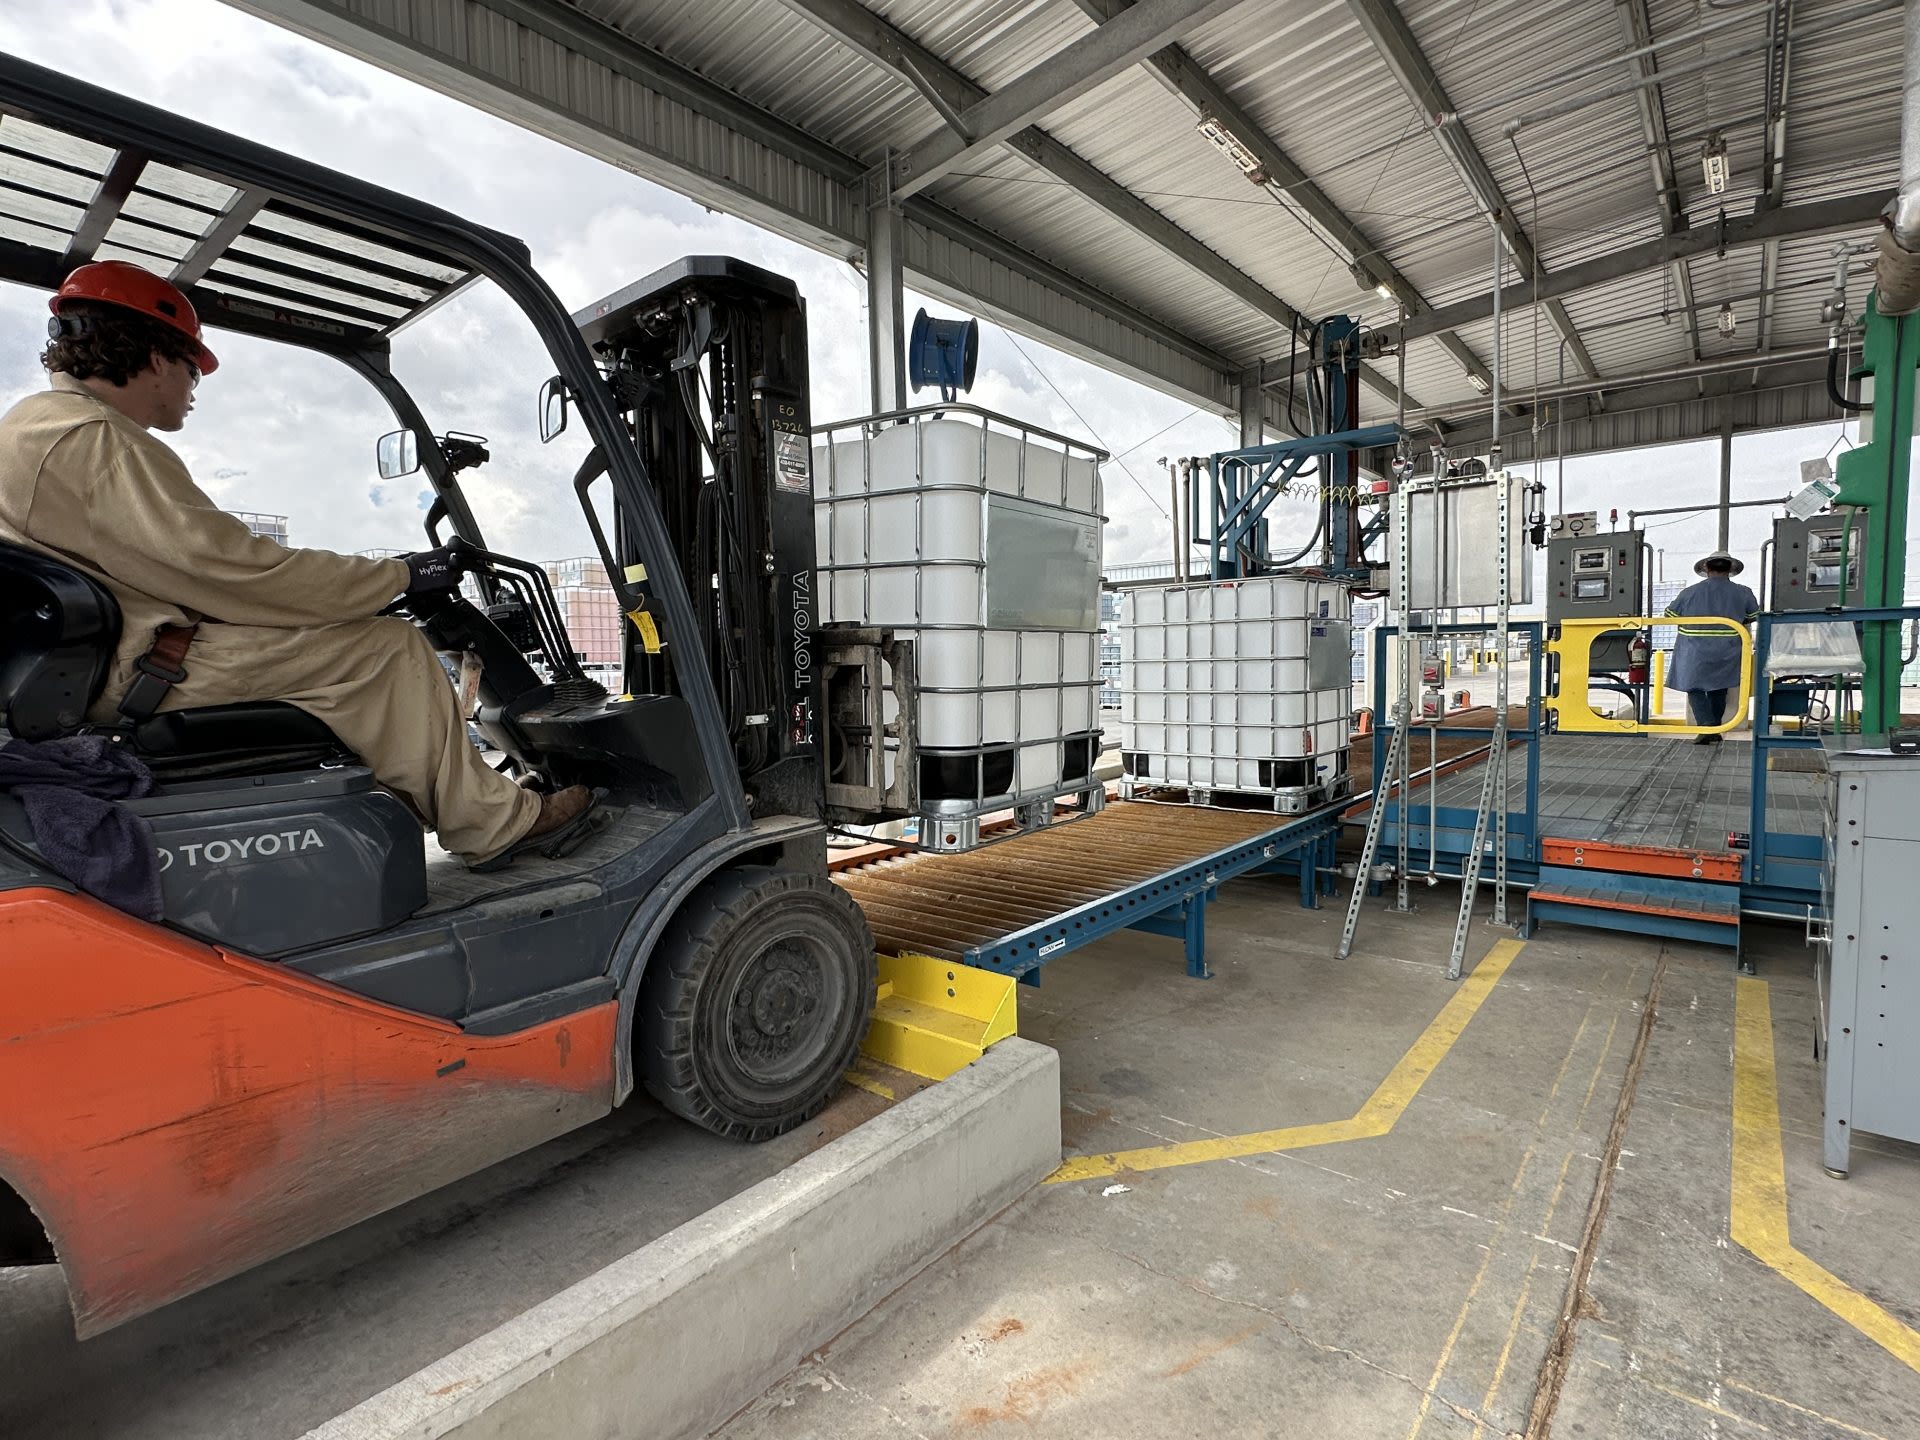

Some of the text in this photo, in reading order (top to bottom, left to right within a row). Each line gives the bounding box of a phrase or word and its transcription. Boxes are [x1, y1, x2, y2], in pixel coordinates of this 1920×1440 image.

[779, 404, 795, 416] EQ
[418, 564, 447, 575] HyFlex
[793, 570, 811, 689] TOYOTA
[179, 828, 324, 866] TOYOTA
